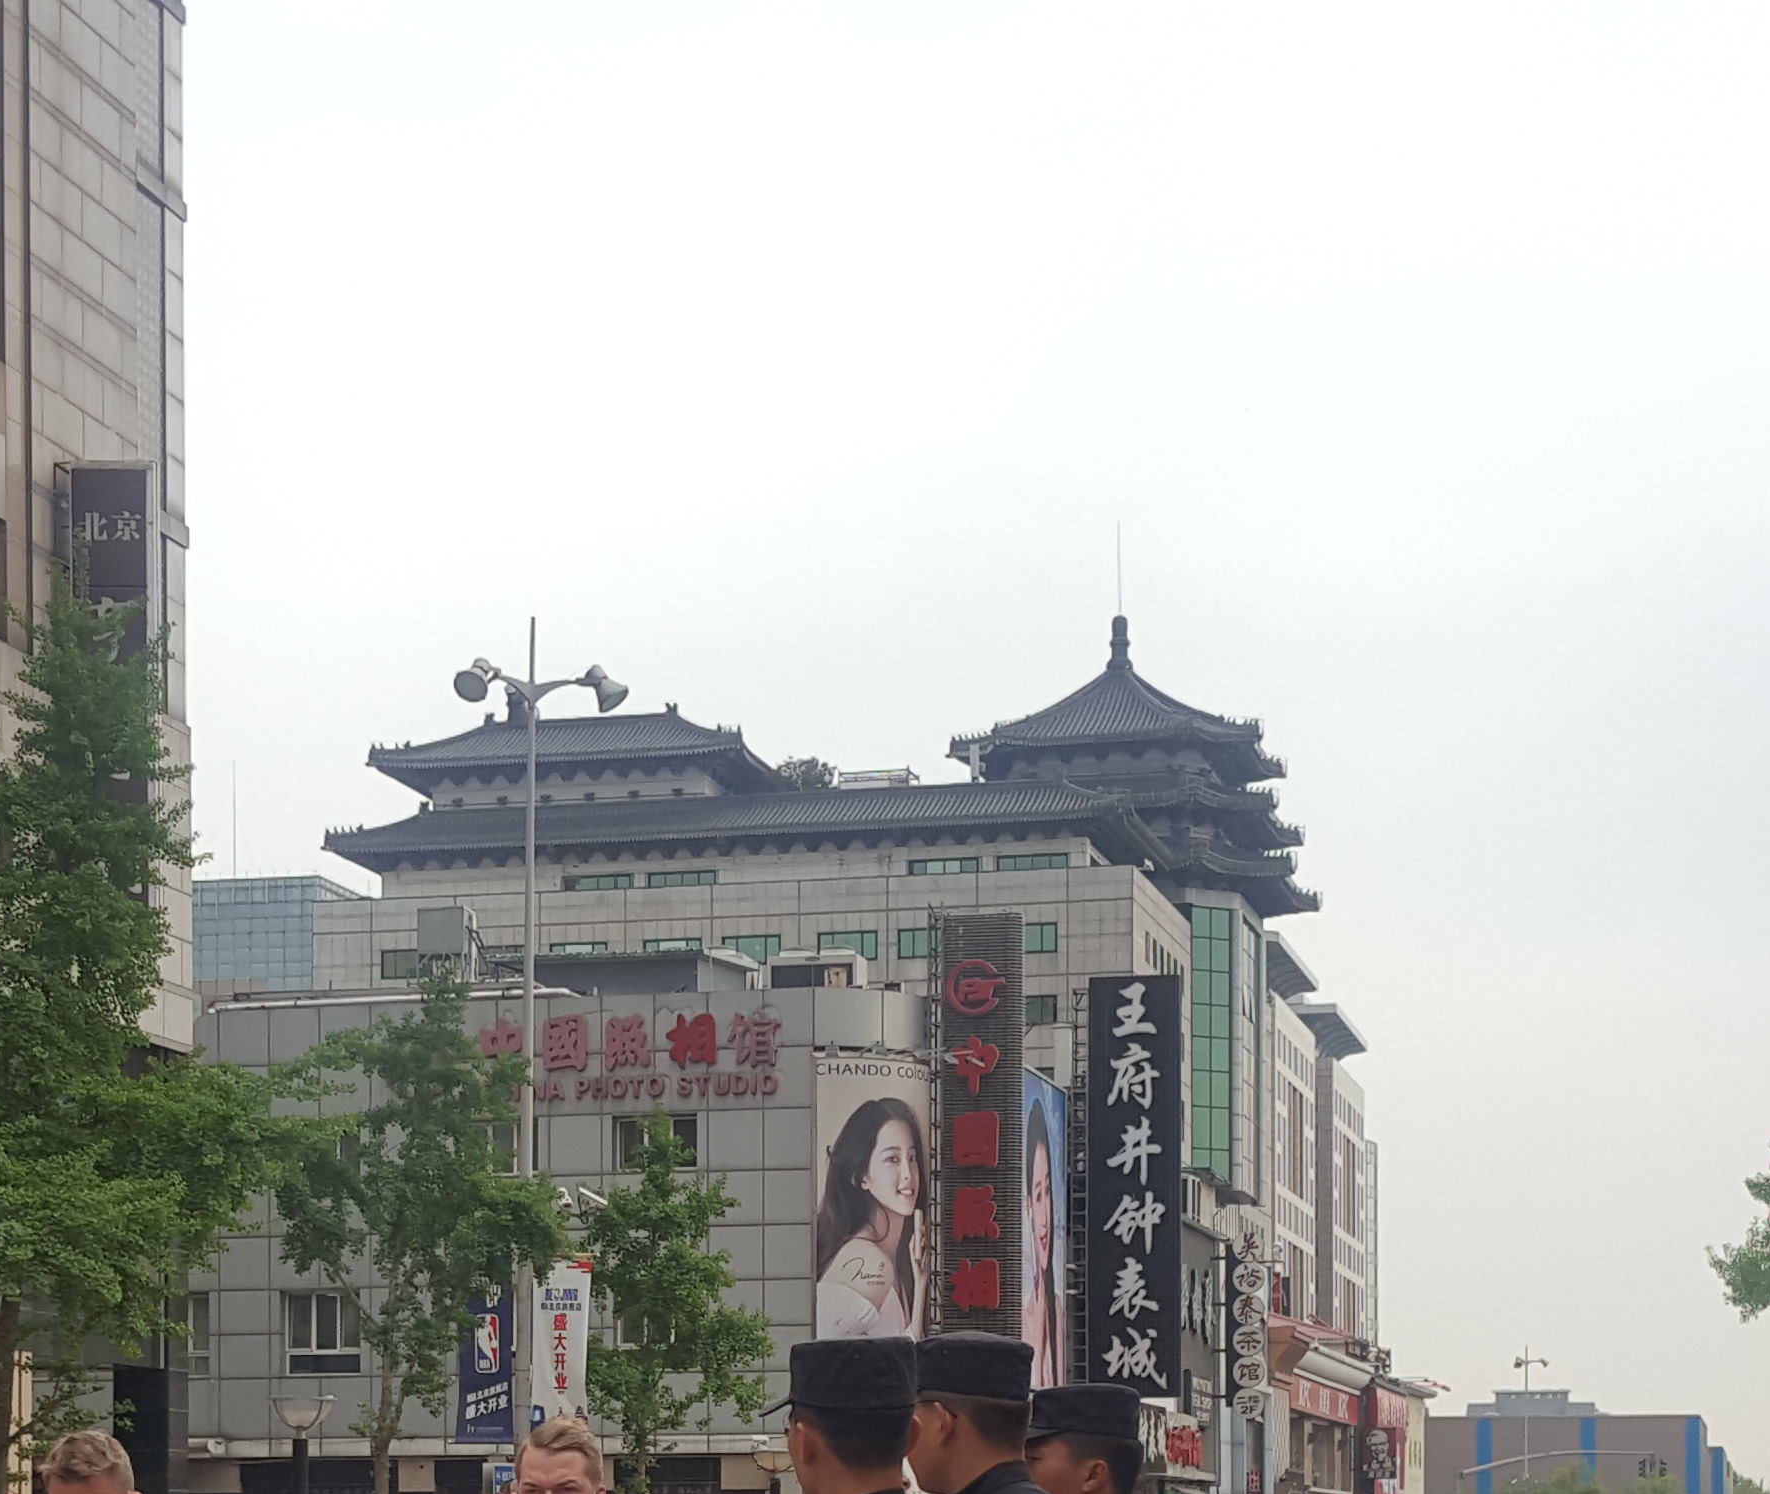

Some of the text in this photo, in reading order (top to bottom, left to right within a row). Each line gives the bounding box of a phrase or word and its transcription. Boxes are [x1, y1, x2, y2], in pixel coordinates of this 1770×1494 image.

[816, 1063, 892, 1077] CHANDO
[578, 1075, 666, 1100] PHOTO
[677, 1073, 779, 1098] STUDIO
[1102, 981, 1168, 1390] 王府井钟表城
[553, 1313, 567, 1390] 盛大开业
[1240, 1405, 1257, 1415] 2F
